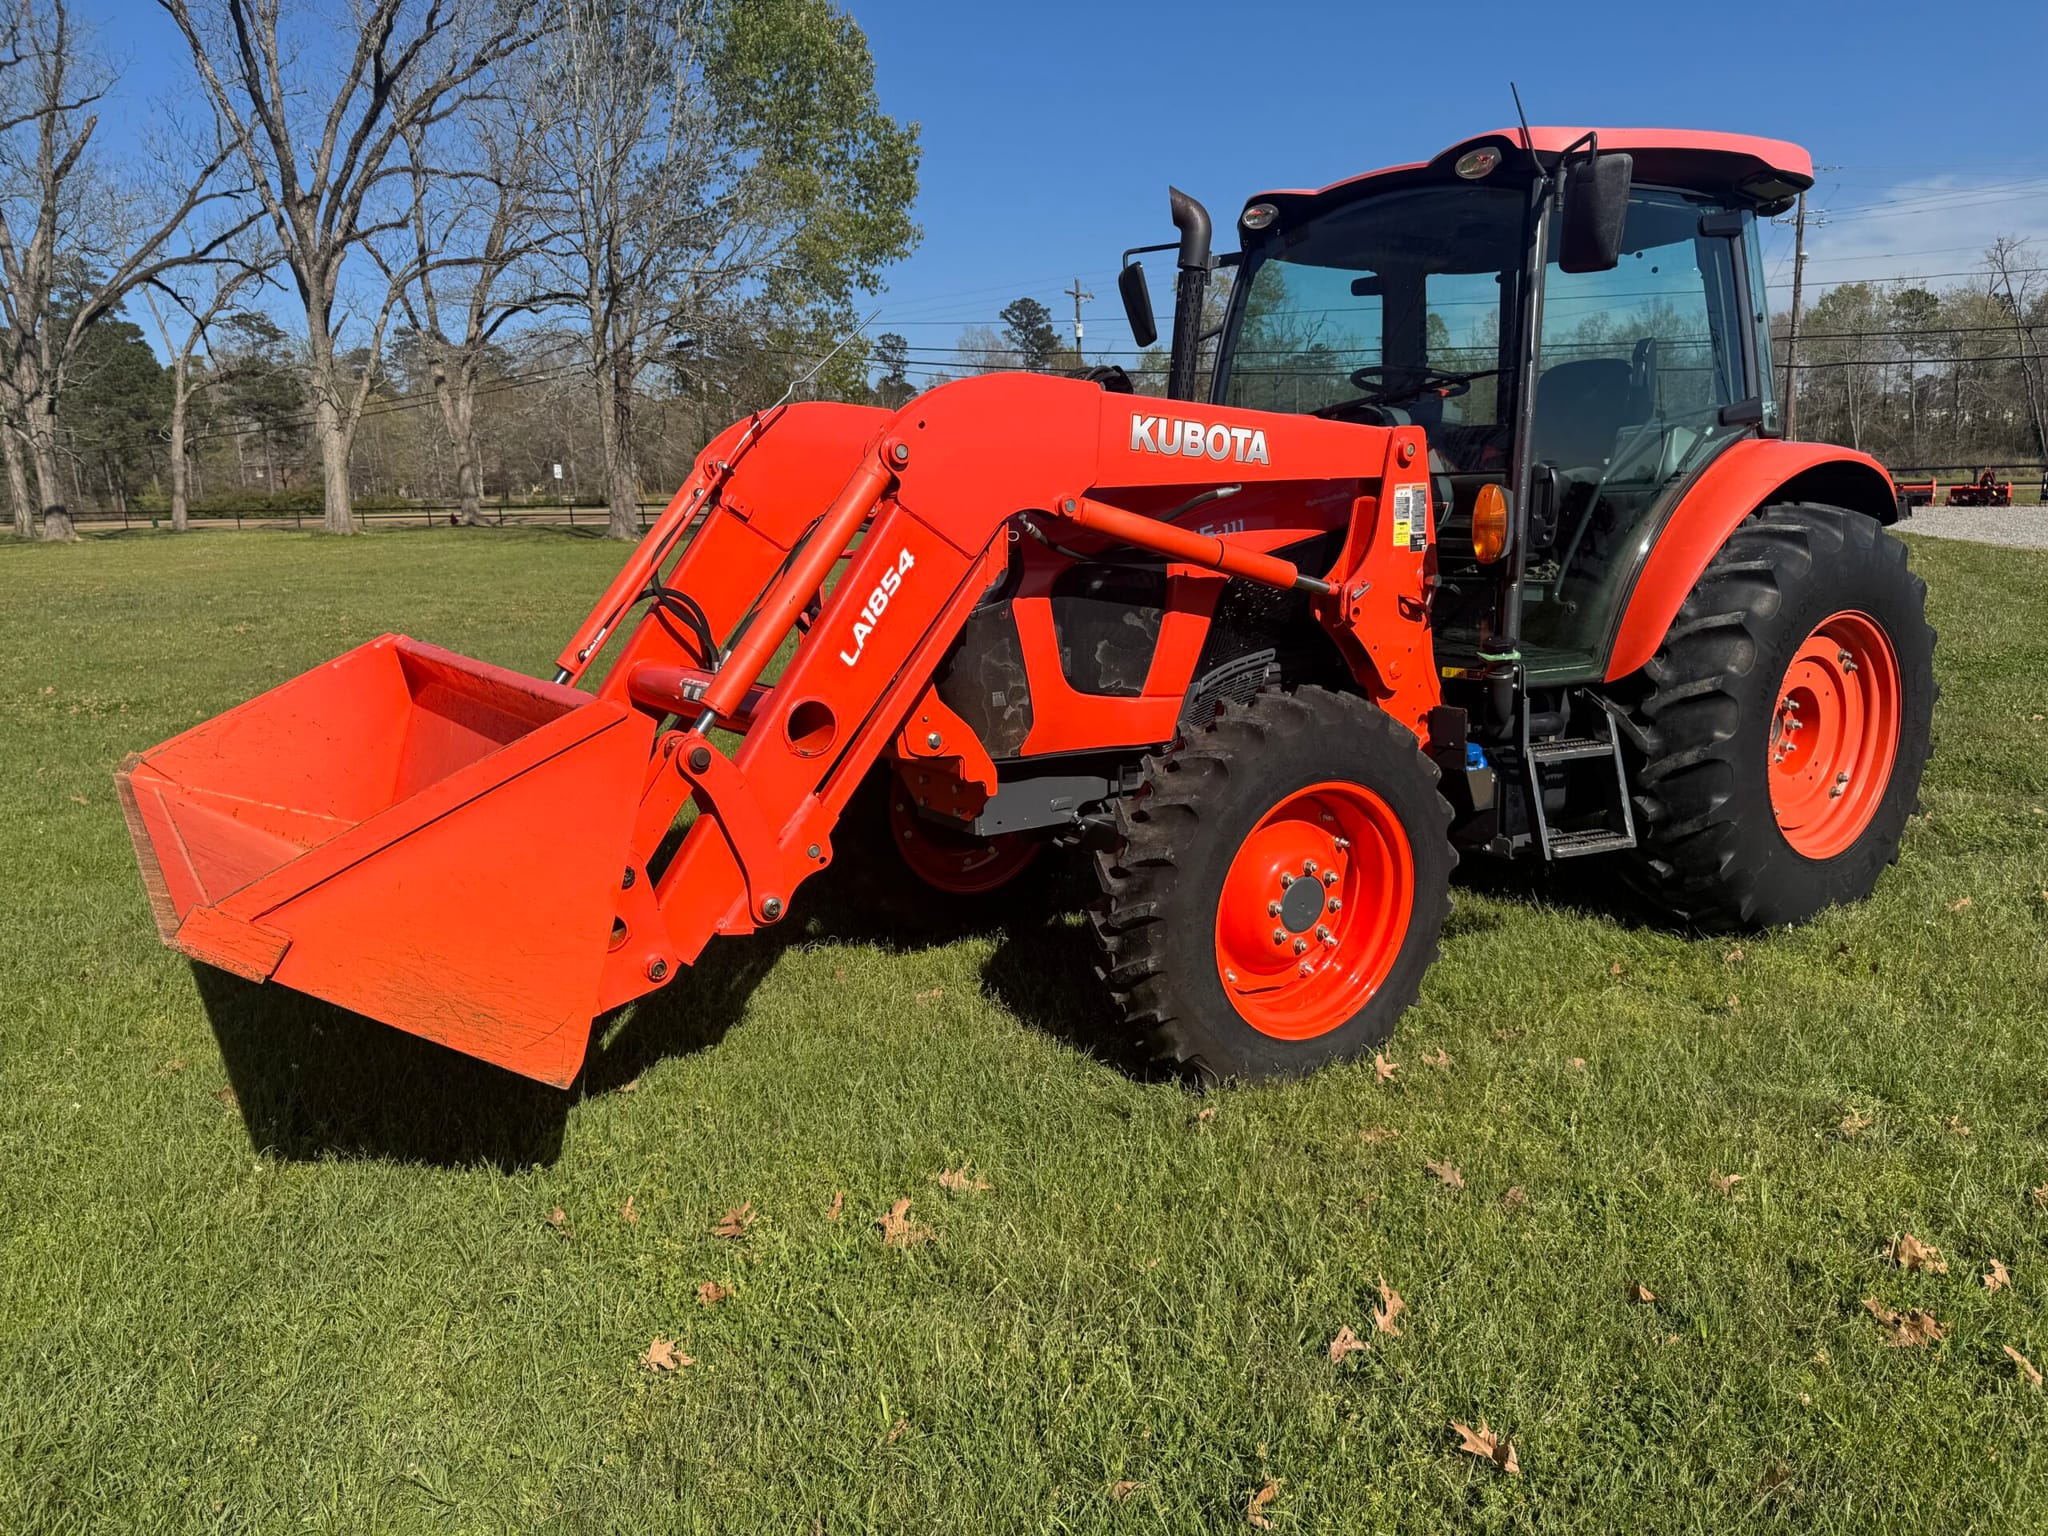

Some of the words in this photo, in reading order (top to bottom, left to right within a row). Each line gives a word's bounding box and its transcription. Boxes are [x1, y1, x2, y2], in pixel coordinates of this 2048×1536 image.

[1130, 413, 1270, 465] KUBOTA
[1194, 518, 1244, 538] 5-111
[840, 548, 915, 666] LA1854
